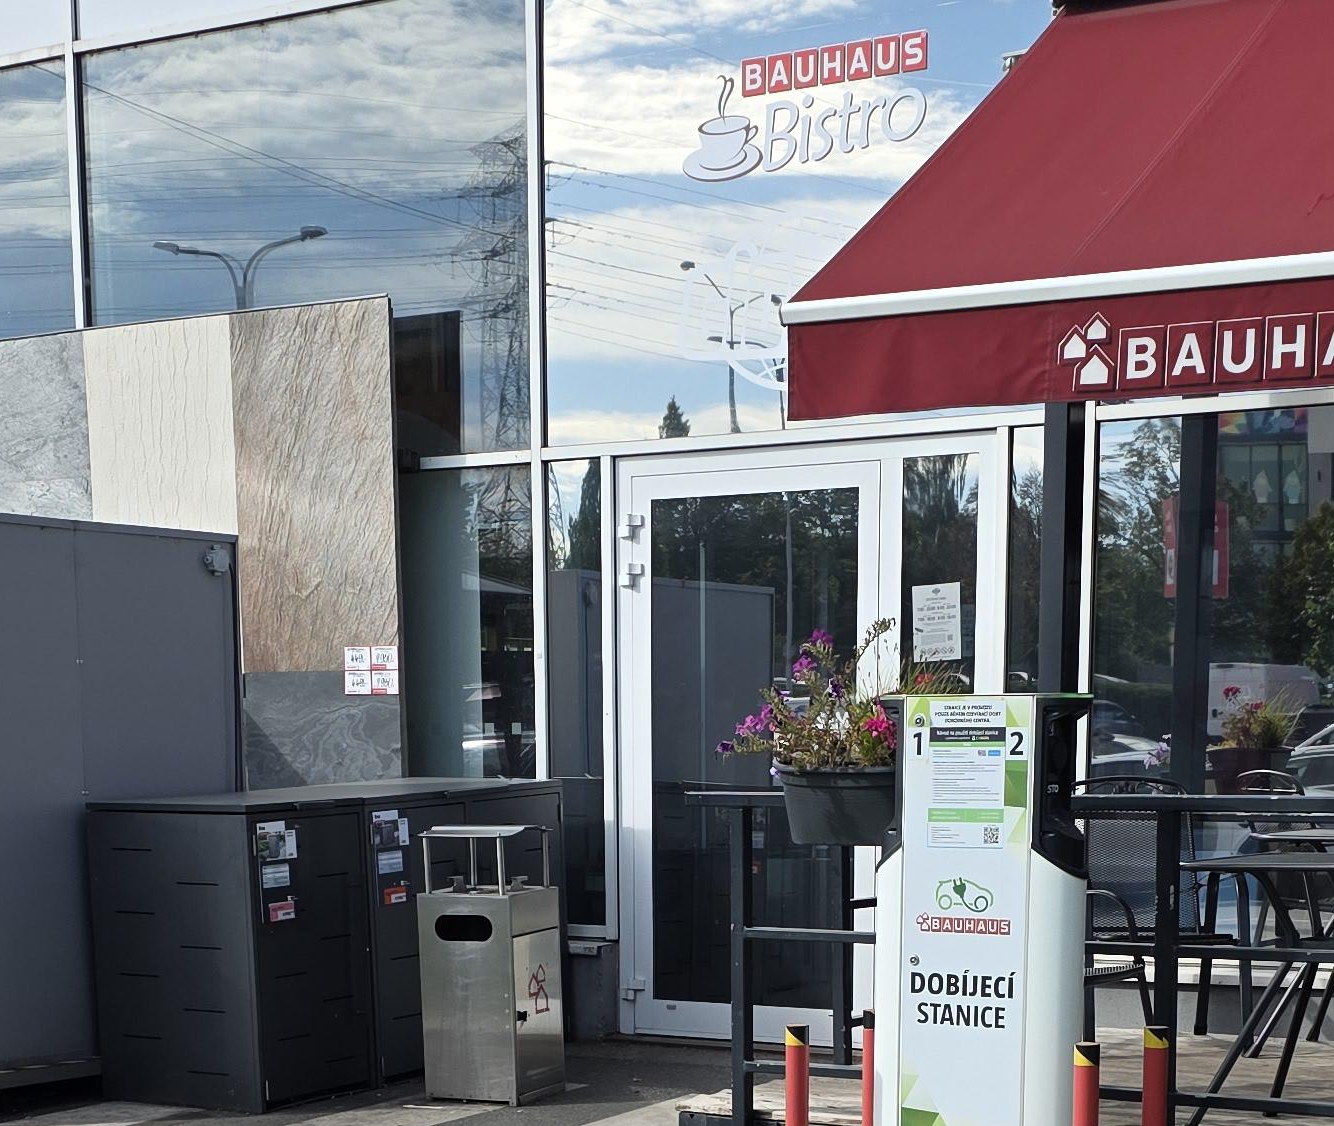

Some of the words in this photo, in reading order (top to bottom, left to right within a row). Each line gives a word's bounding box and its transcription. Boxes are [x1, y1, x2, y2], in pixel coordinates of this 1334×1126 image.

[743, 34, 925, 92] BAUHAUS
[762, 87, 927, 172] Bistro
[913, 732, 922, 756] 1
[1009, 731, 1024, 756] 2
[931, 918, 1010, 934] BAUHAUS
[910, 969, 1016, 999] DOBÍJECÍ
[917, 1001, 1006, 1029] STANICE
